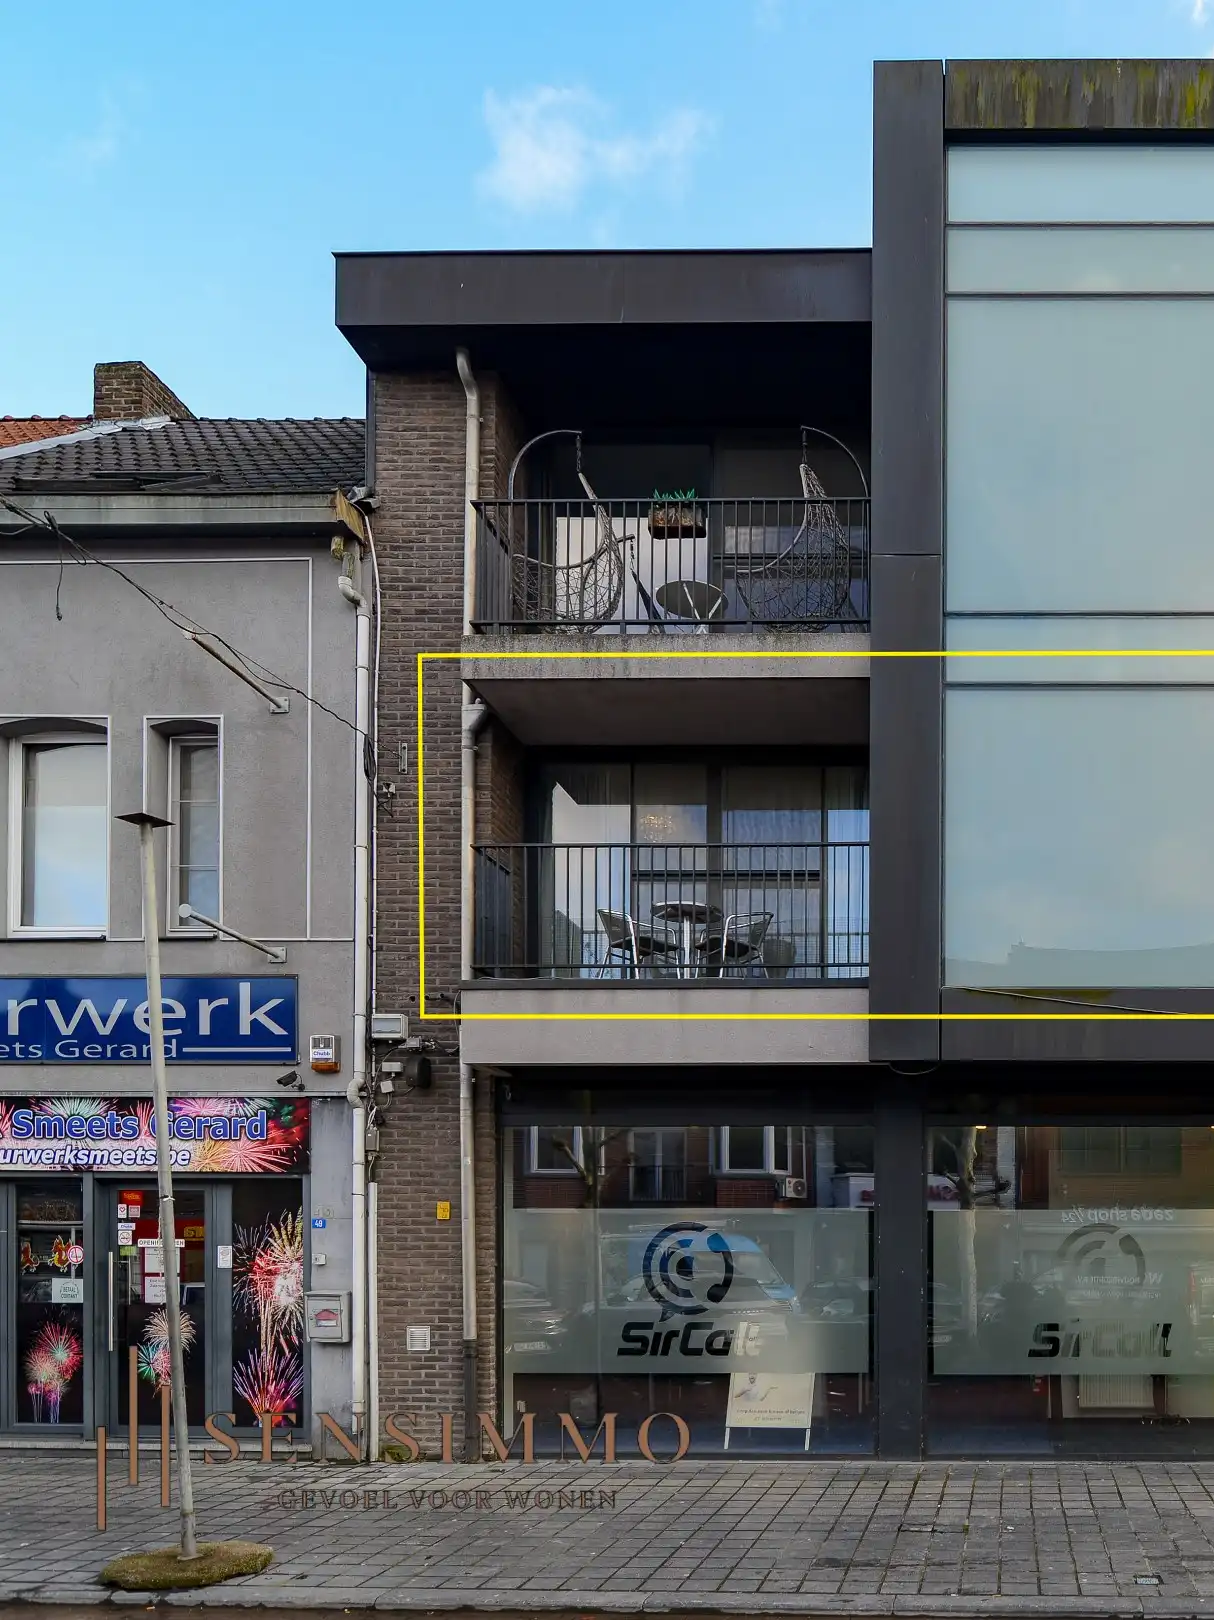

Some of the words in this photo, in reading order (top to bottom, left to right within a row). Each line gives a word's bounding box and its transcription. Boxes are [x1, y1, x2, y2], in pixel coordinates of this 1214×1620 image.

[7, 982, 289, 1036] rwerk
[54, 1039, 178, 1058] Gerard
[12, 1109, 140, 1139] Smeets
[0, 1144, 191, 1165] urwerksmeetsbe
[314, 1219, 323, 1228] 49
